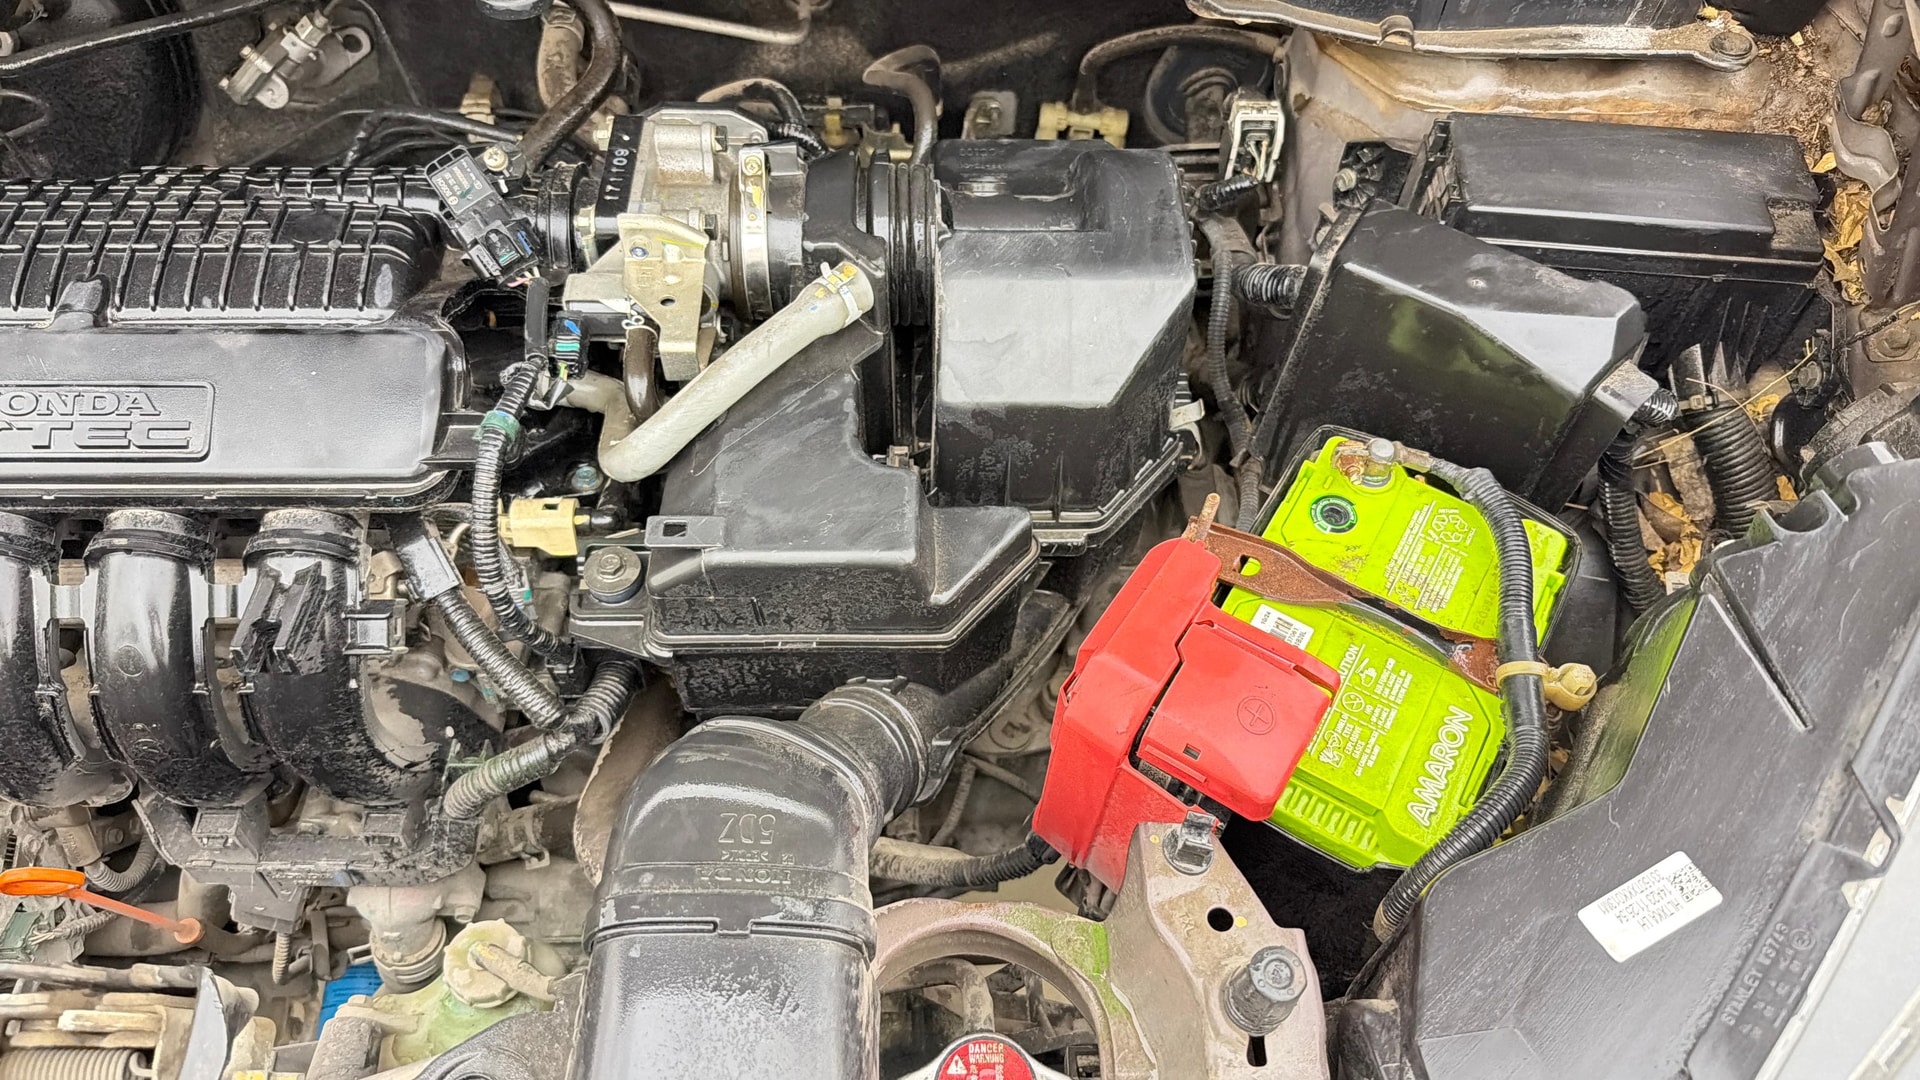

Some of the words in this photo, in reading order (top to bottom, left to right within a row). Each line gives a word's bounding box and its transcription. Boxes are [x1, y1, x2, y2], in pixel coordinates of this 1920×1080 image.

[603, 148, 629, 200] 171109
[0, 391, 161, 416] ONDA
[0, 420, 191, 449] TEC
[1407, 705, 1475, 828] AMARON
[1720, 968, 1763, 1026] STANLEY
